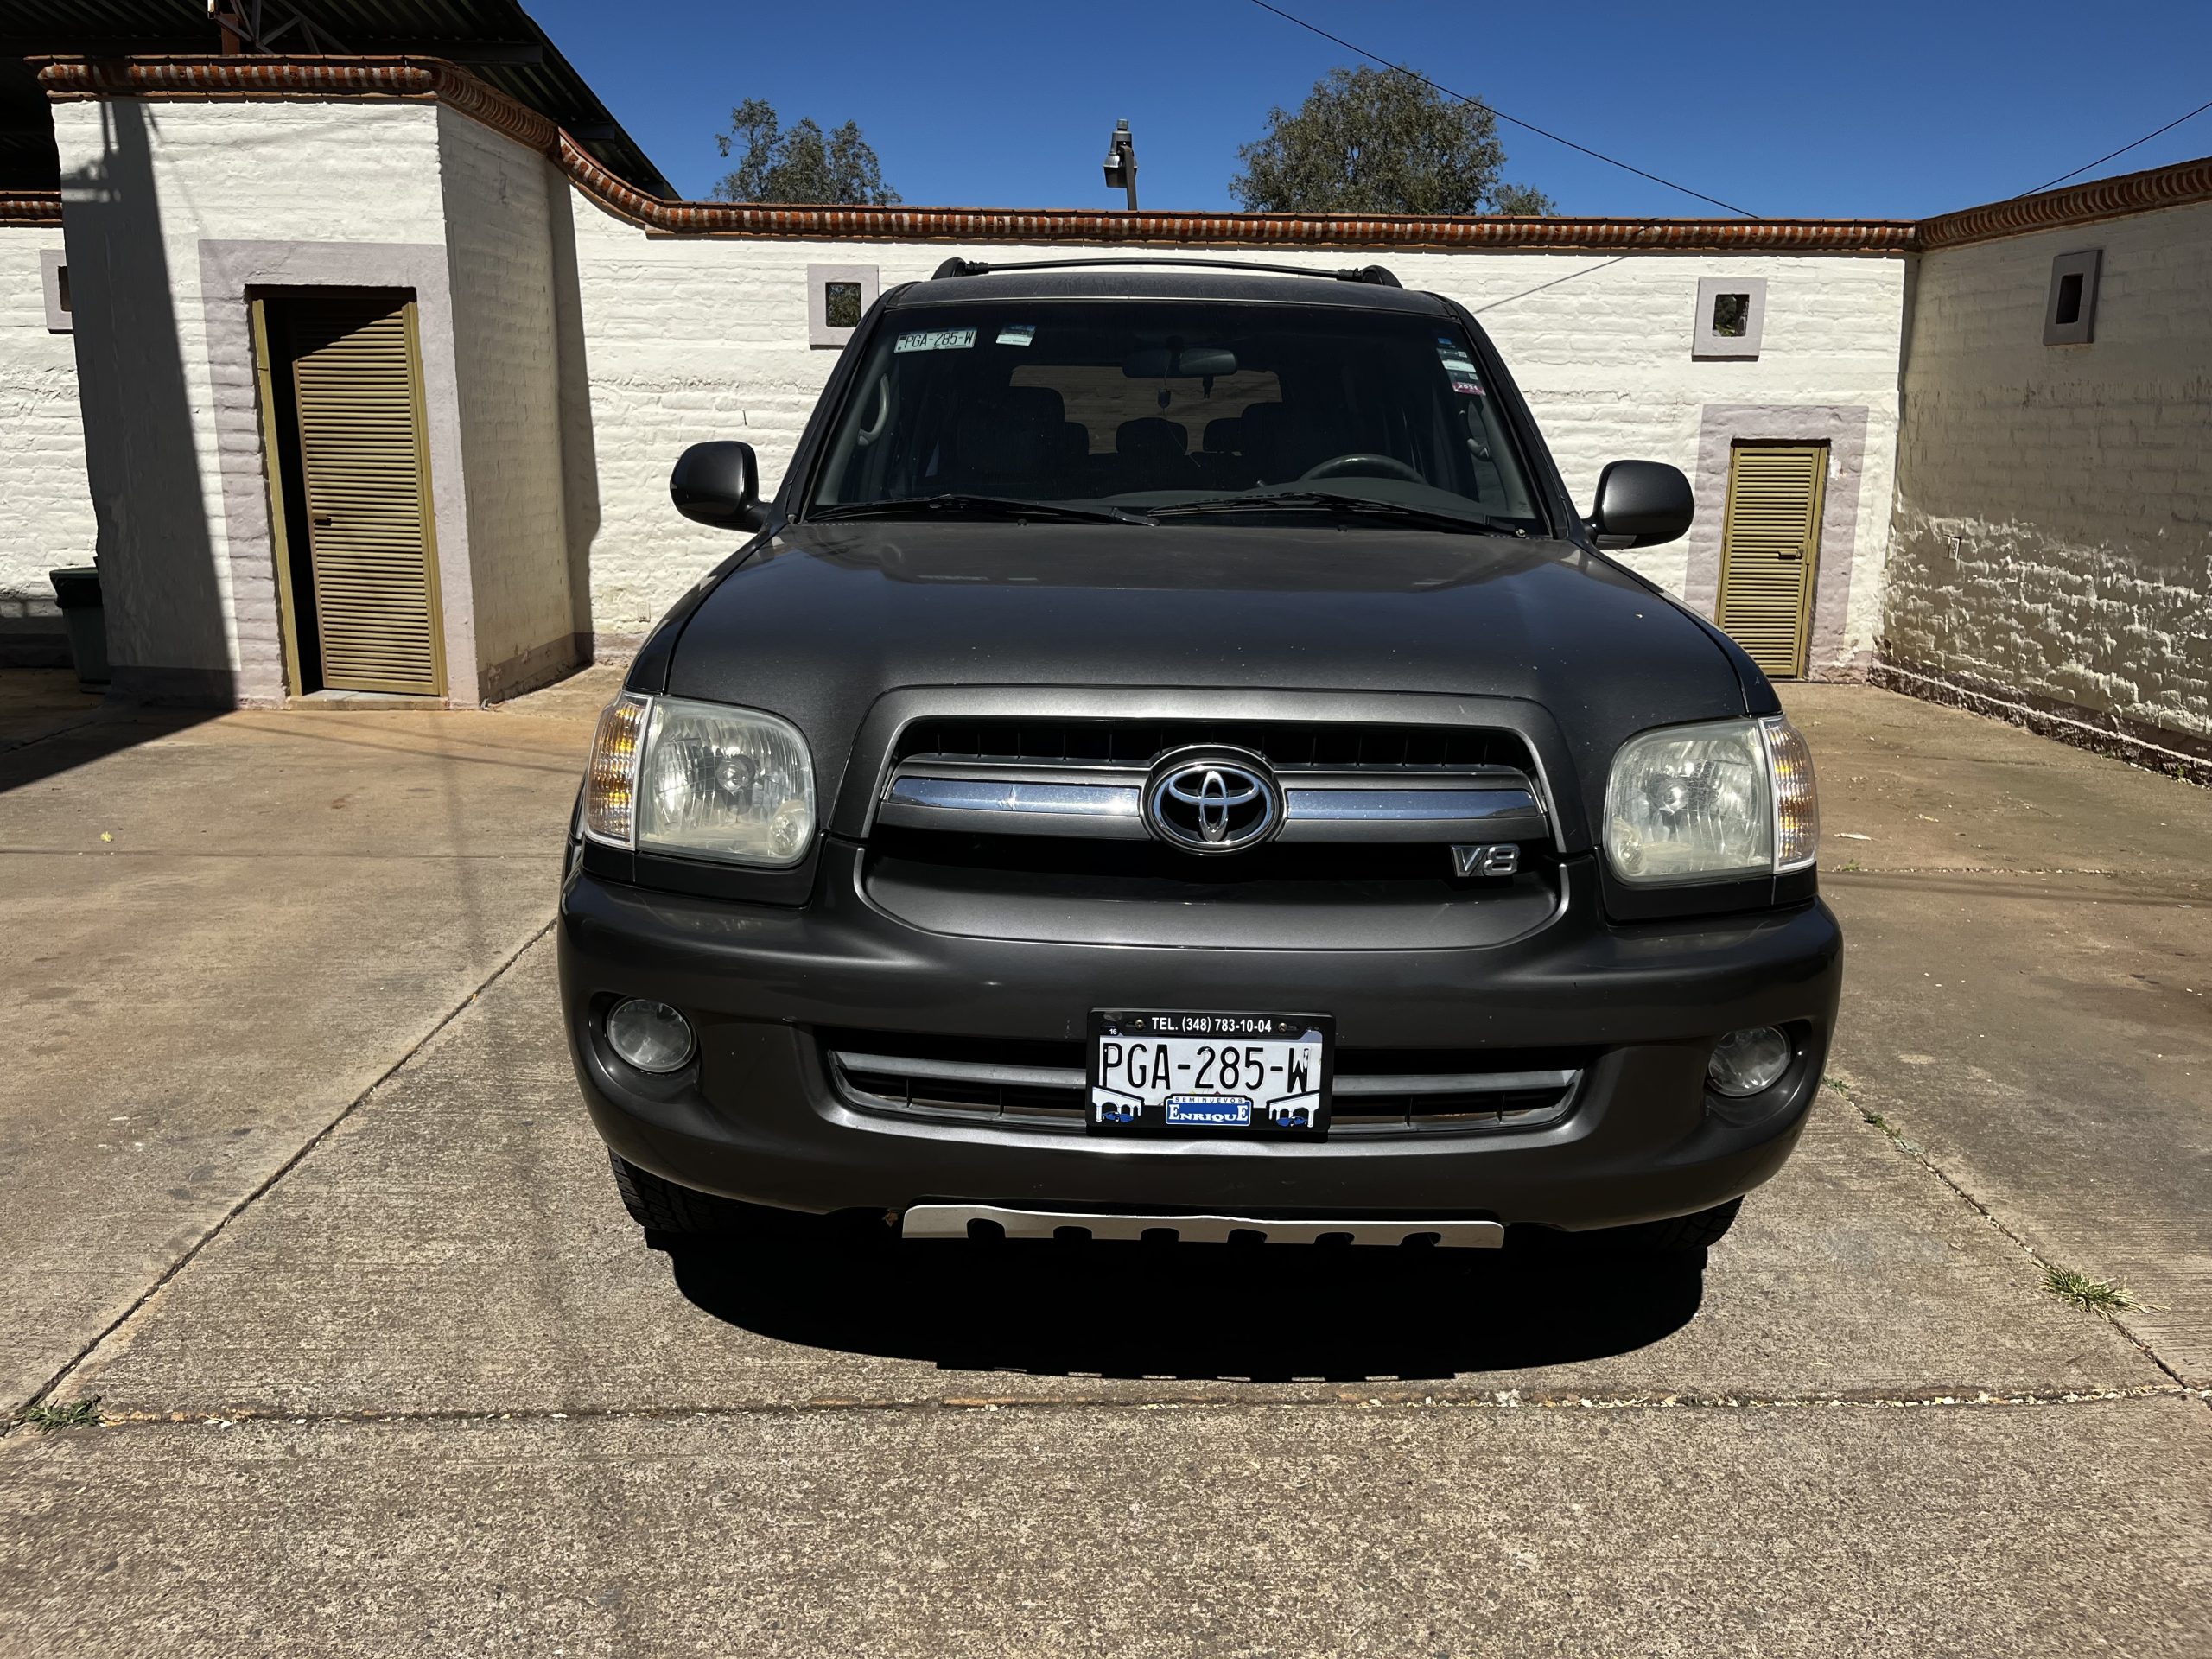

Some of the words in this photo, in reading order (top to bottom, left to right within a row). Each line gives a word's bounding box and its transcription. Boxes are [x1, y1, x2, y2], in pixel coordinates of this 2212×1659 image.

[904, 331, 975, 348] PGA-285-W
[1451, 844, 1520, 877] V8
[1152, 1017, 1179, 1030] TEL.
[1182, 1016, 1211, 1033] (348)
[1214, 1019, 1272, 1033] 783-10-04
[1102, 1043, 1309, 1093] PGA-285-W
